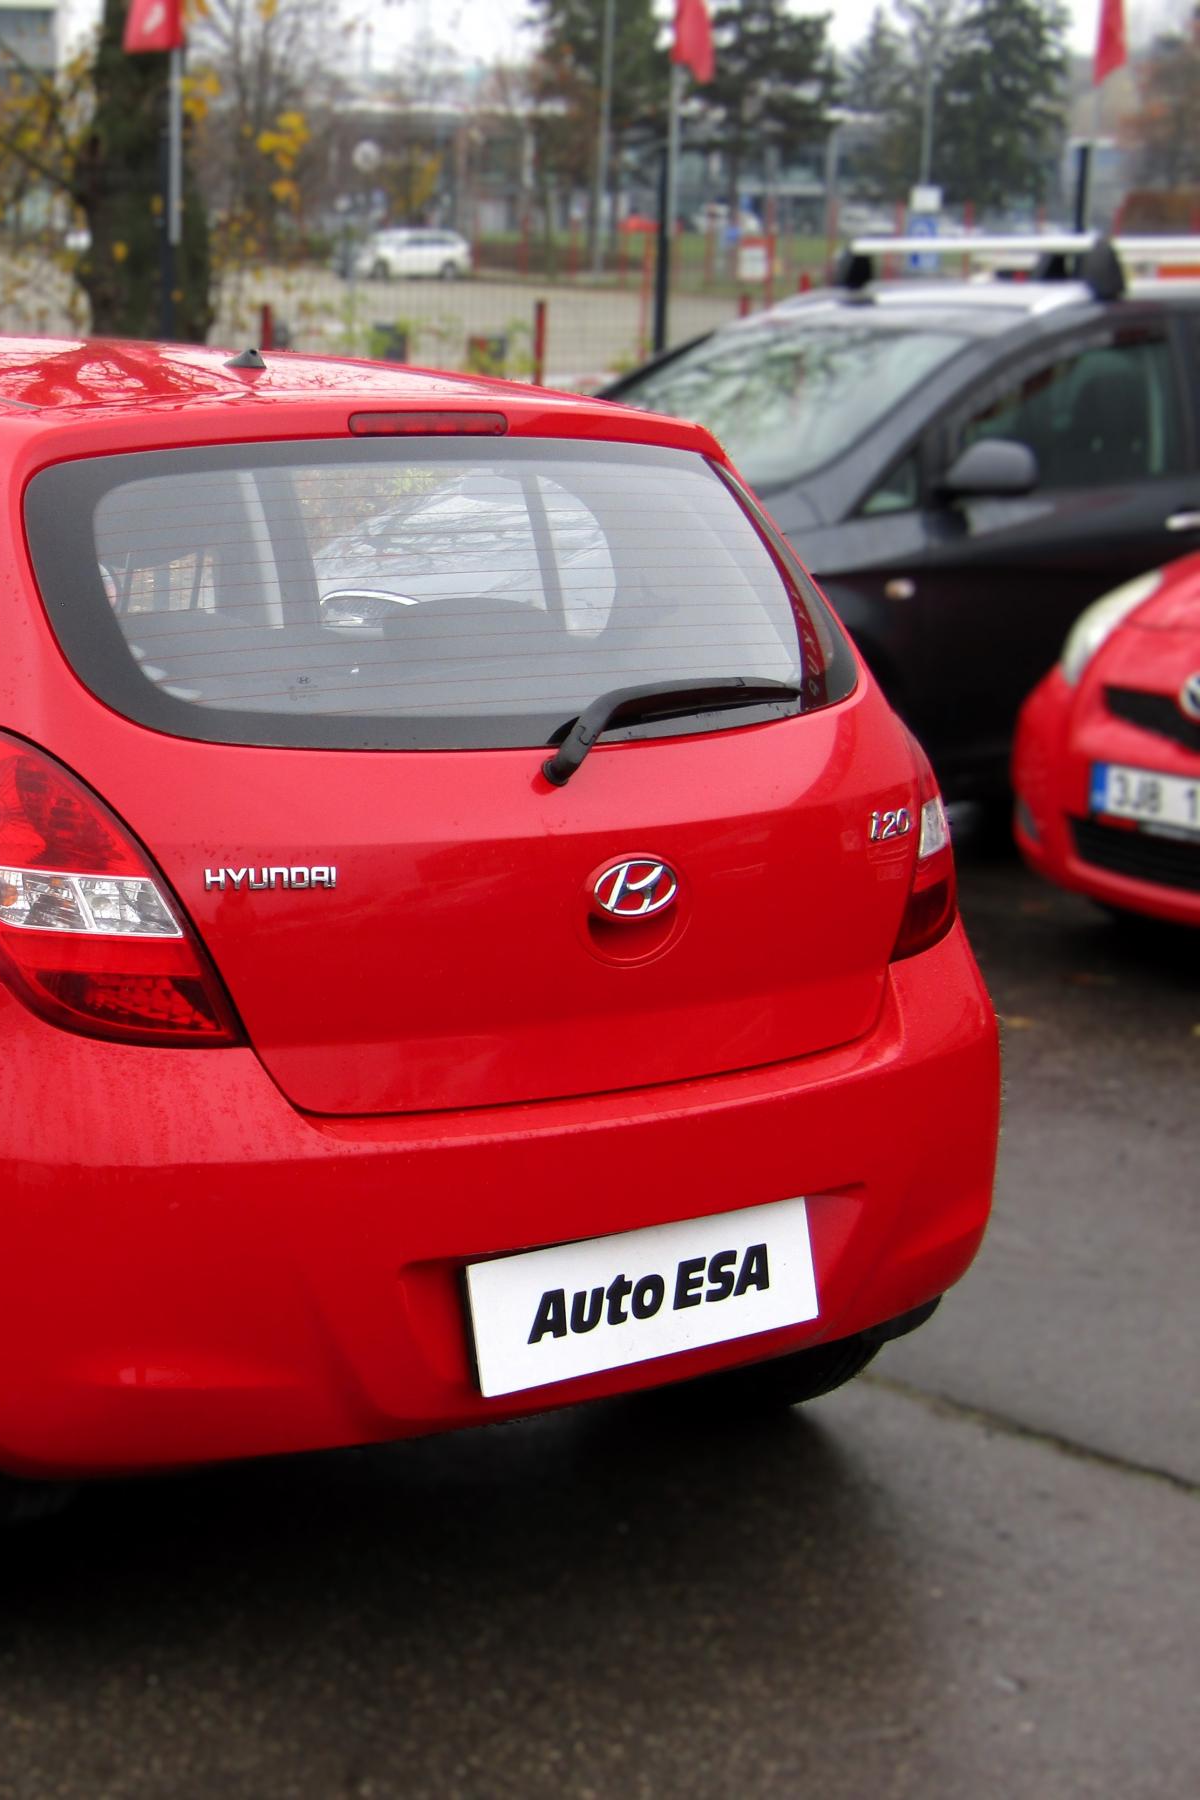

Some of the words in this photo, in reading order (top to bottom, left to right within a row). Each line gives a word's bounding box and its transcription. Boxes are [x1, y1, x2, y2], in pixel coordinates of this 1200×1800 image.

[870, 807, 910, 840] i20
[204, 866, 337, 890] HYUNDAI
[527, 1273, 665, 1345] Auto
[672, 1242, 770, 1311] ESA
